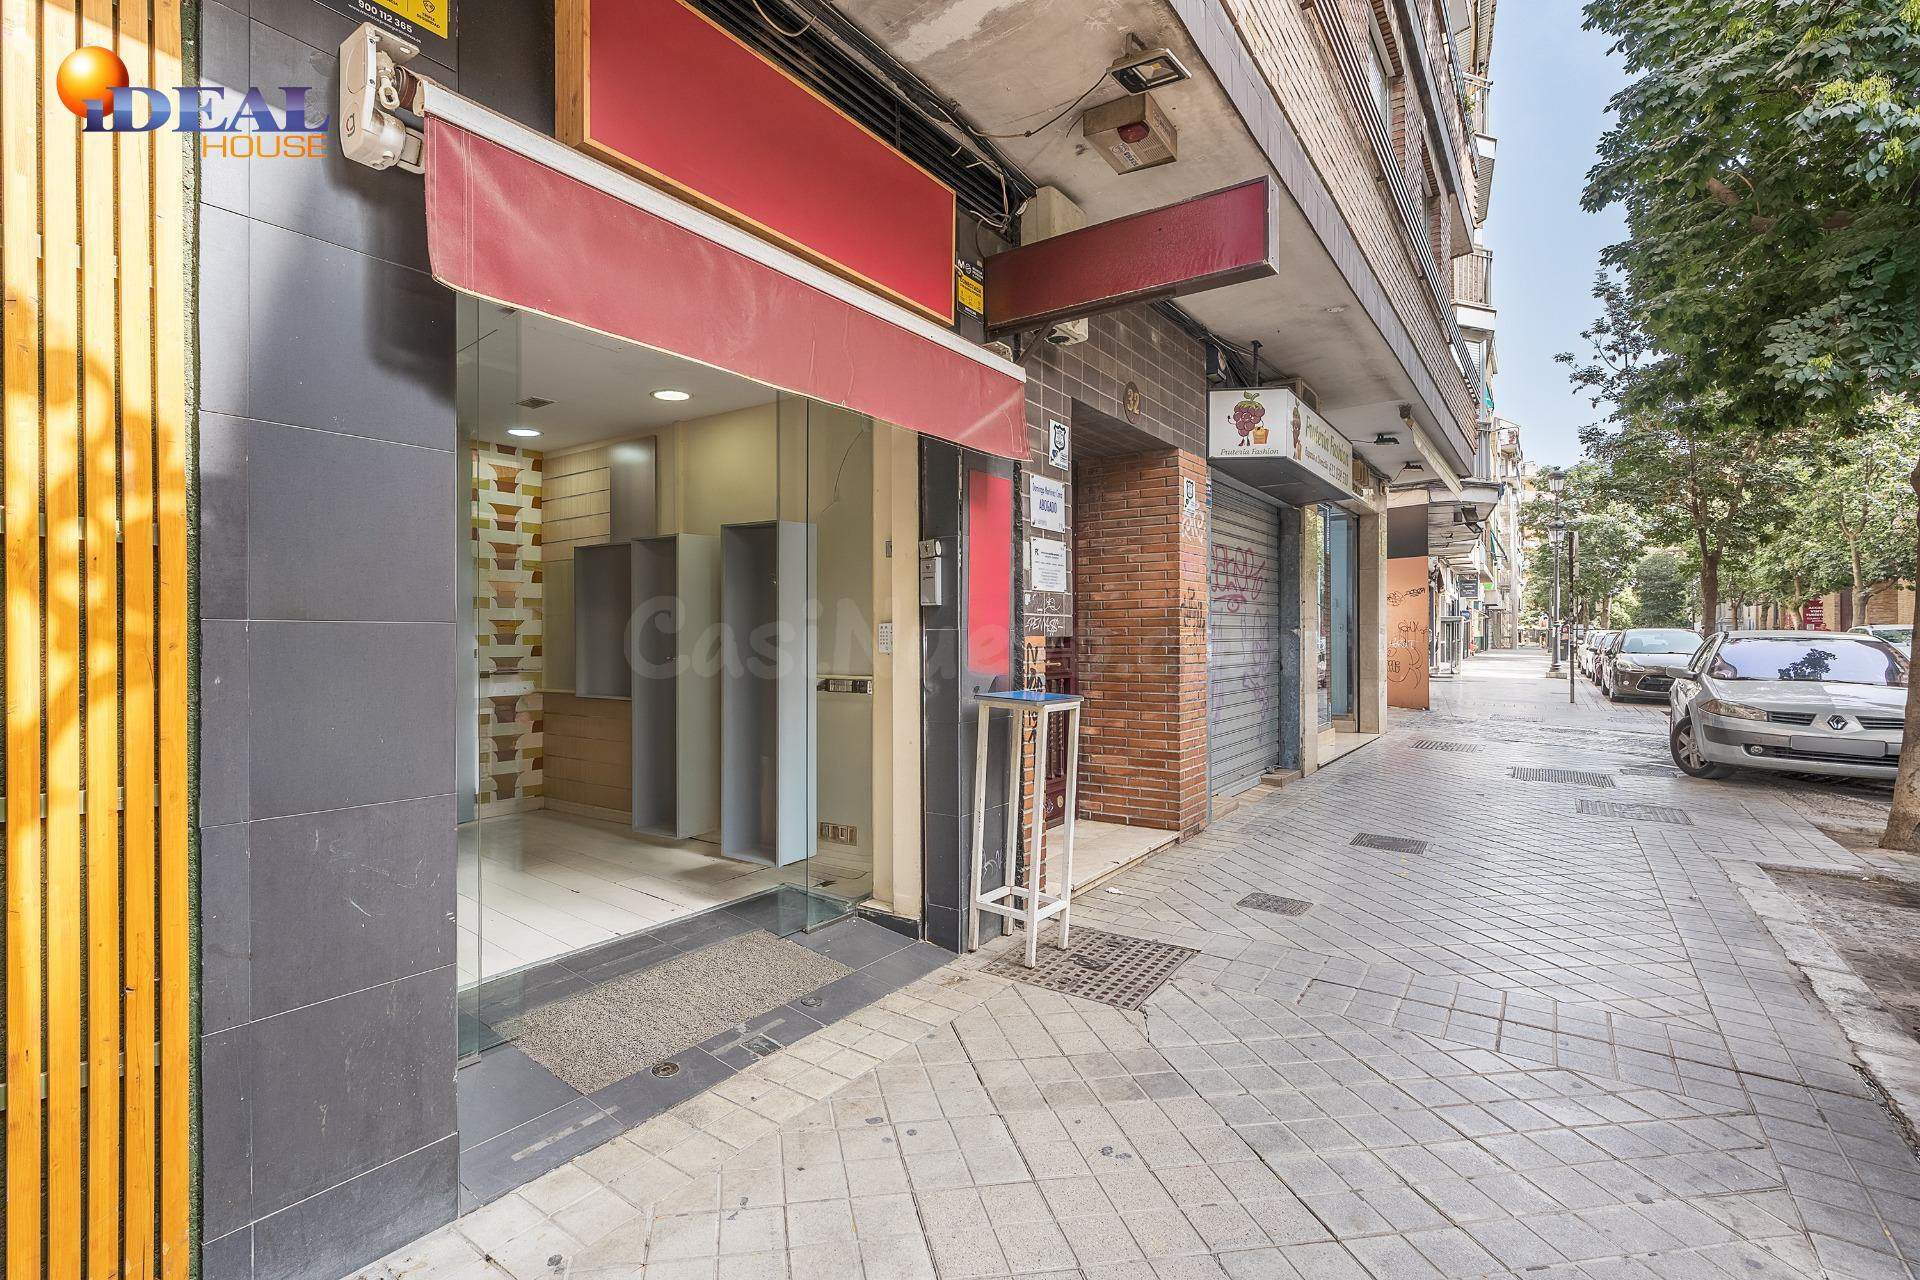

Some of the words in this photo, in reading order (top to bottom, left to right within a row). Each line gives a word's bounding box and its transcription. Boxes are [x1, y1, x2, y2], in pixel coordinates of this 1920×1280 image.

[358, 0, 378, 15] 900
[379, 9, 393, 23] 112
[394, 18, 413, 33] 365
[1126, 388, 1140, 415] 32
[1251, 447, 1280, 456] Fashion
[1329, 433, 1349, 468] Fashion
[1039, 498, 1058, 514] ABOGADO
